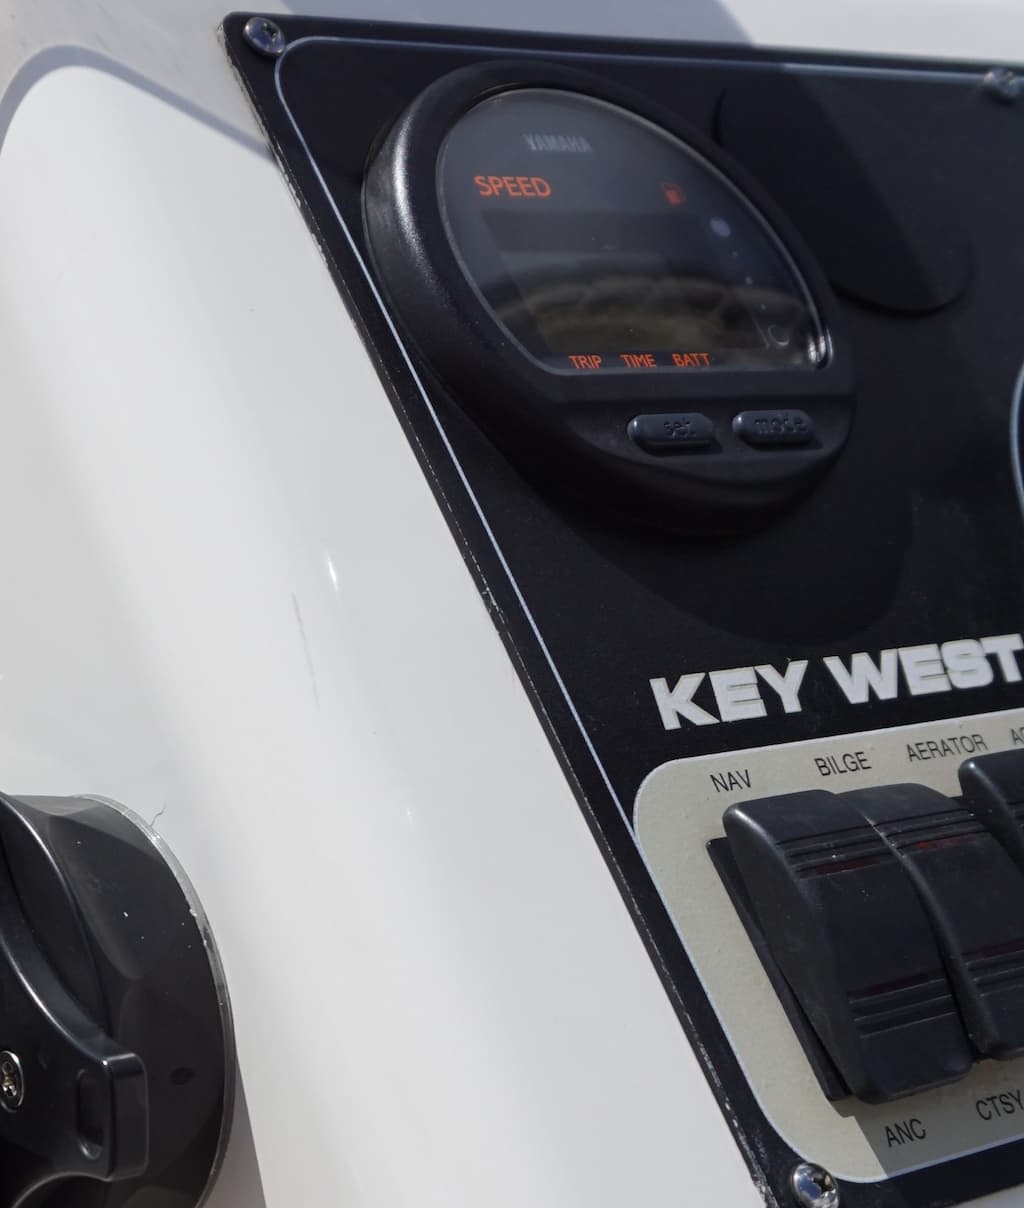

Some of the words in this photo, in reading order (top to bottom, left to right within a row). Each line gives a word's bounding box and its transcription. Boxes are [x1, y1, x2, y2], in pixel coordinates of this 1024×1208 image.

[523, 133, 593, 152] YAMAHA
[474, 175, 552, 197] SPEED
[568, 354, 603, 369] TRIP
[620, 353, 657, 368] TIME
[672, 352, 711, 367] BATT
[649, 659, 809, 731] KEY
[823, 633, 1023, 705] WEST
[710, 769, 752, 794] NAV
[814, 751, 872, 777] BILGE
[906, 734, 989, 762] AERATOR
[884, 1118, 926, 1148] ANC
[976, 1089, 1024, 1121] CTSY
